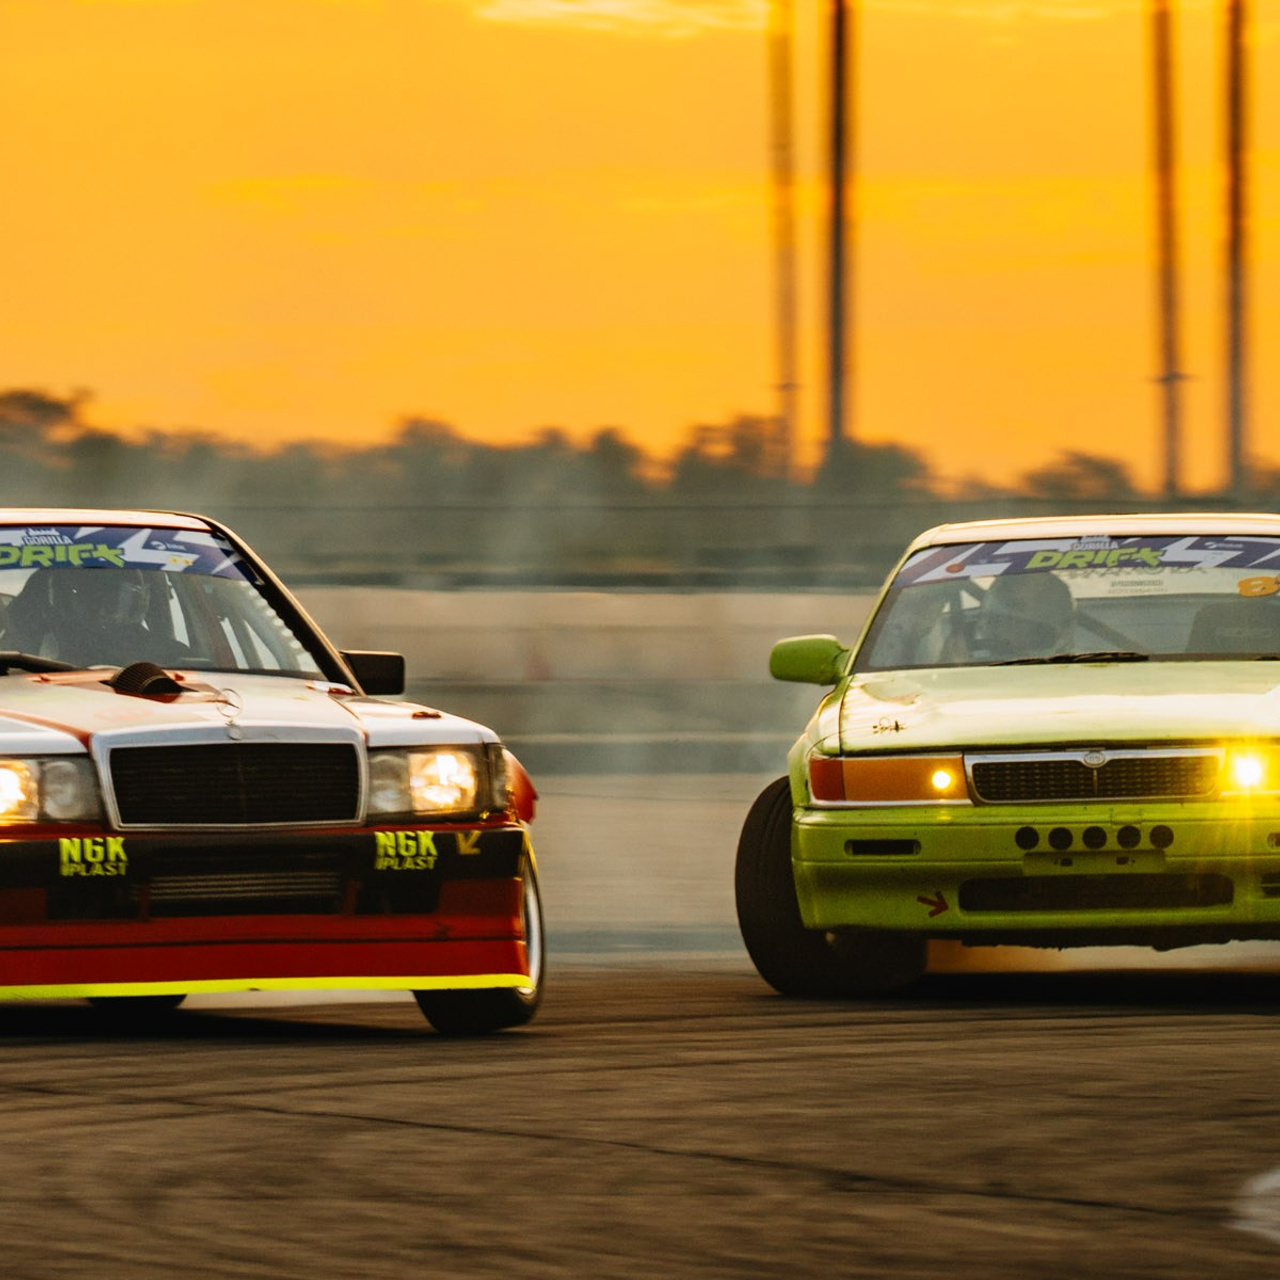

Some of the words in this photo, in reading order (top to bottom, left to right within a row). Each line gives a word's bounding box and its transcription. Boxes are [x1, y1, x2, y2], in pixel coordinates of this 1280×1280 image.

[22, 534, 74, 546] GORILLA
[1025, 547, 1166, 568] DRIFT
[59, 837, 128, 862] NGK
[375, 830, 438, 856] NGK
